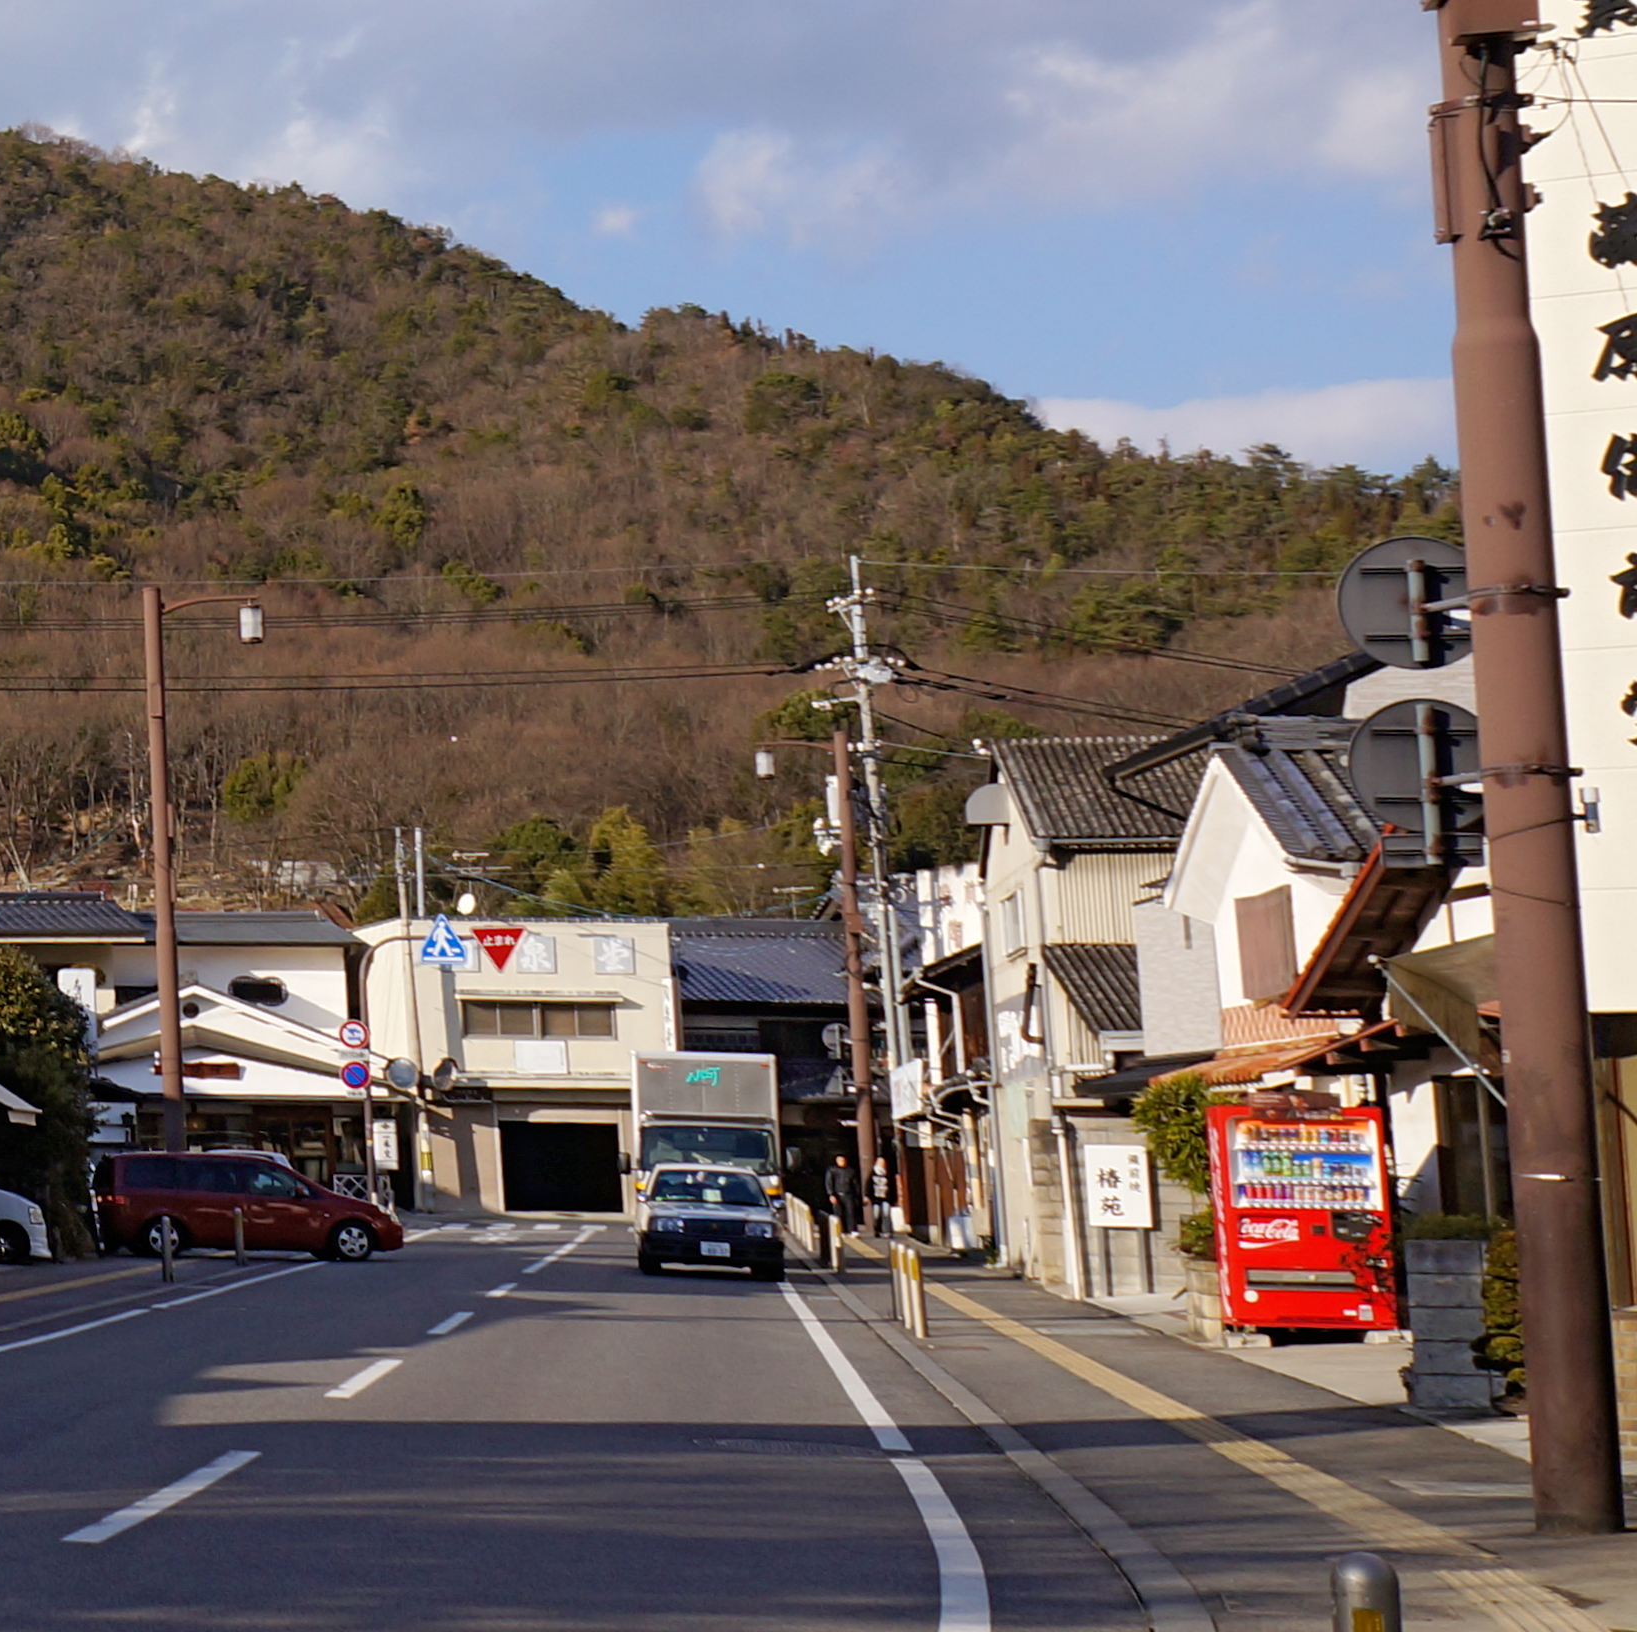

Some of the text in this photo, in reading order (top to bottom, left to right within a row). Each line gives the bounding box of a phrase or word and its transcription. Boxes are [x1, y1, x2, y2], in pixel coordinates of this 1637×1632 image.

[482, 934, 516, 946] 止まれ
[1095, 1168, 1125, 1216] 椿苑
